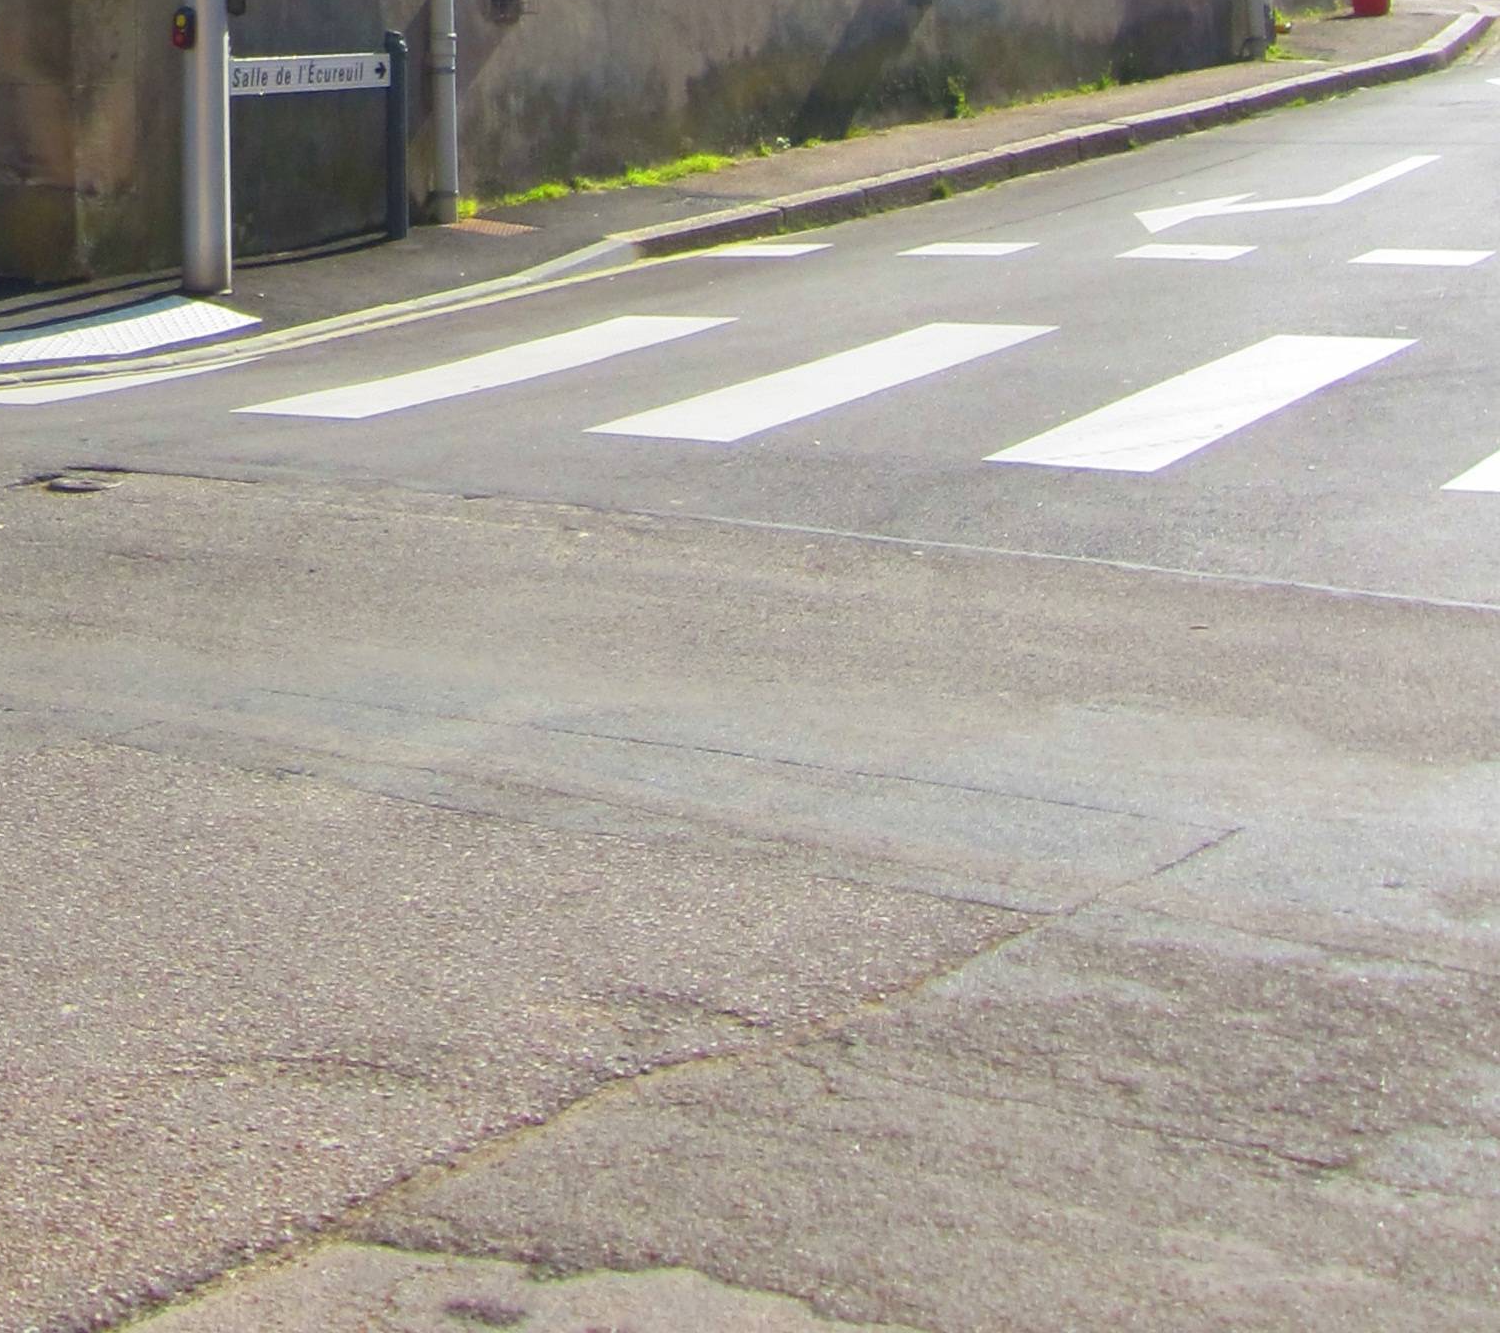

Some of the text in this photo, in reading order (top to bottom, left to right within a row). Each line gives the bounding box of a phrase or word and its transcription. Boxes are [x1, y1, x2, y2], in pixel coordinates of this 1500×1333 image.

[232, 60, 364, 88] Salle de l'Écureuil
